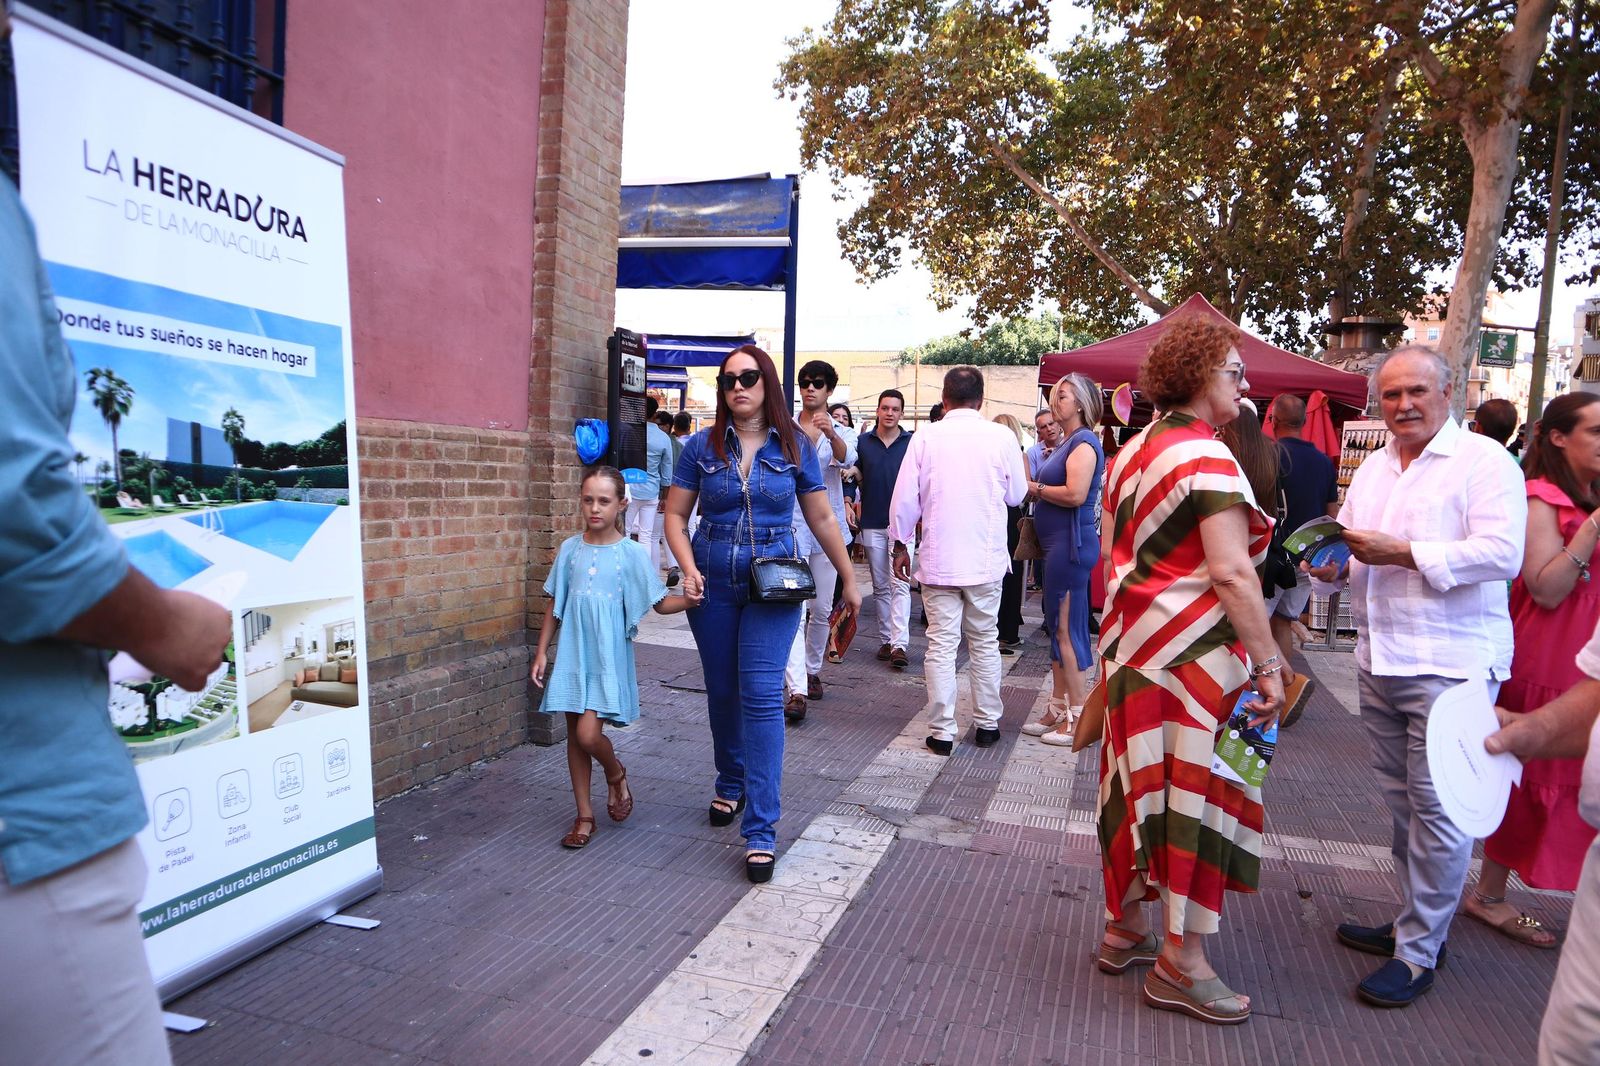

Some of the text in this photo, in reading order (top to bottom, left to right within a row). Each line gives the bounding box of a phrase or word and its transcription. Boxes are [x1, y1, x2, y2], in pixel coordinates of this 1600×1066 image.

[83, 139, 308, 243] LA HERRADURA
[124, 199, 281, 264] DE LA MONACILLA
[116, 320, 144, 339] tus
[150, 327, 203, 349] sueños
[207, 338, 223, 352] se
[227, 338, 268, 360] hacen
[272, 347, 308, 367] hogar
[326, 784, 351, 799] Jardines
[284, 804, 300, 814] Club
[283, 813, 302, 825] Social
[227, 823, 247, 835] Zona
[225, 832, 251, 847] Infantil
[165, 846, 186, 858] Pista
[159, 853, 194, 873] de Padel
